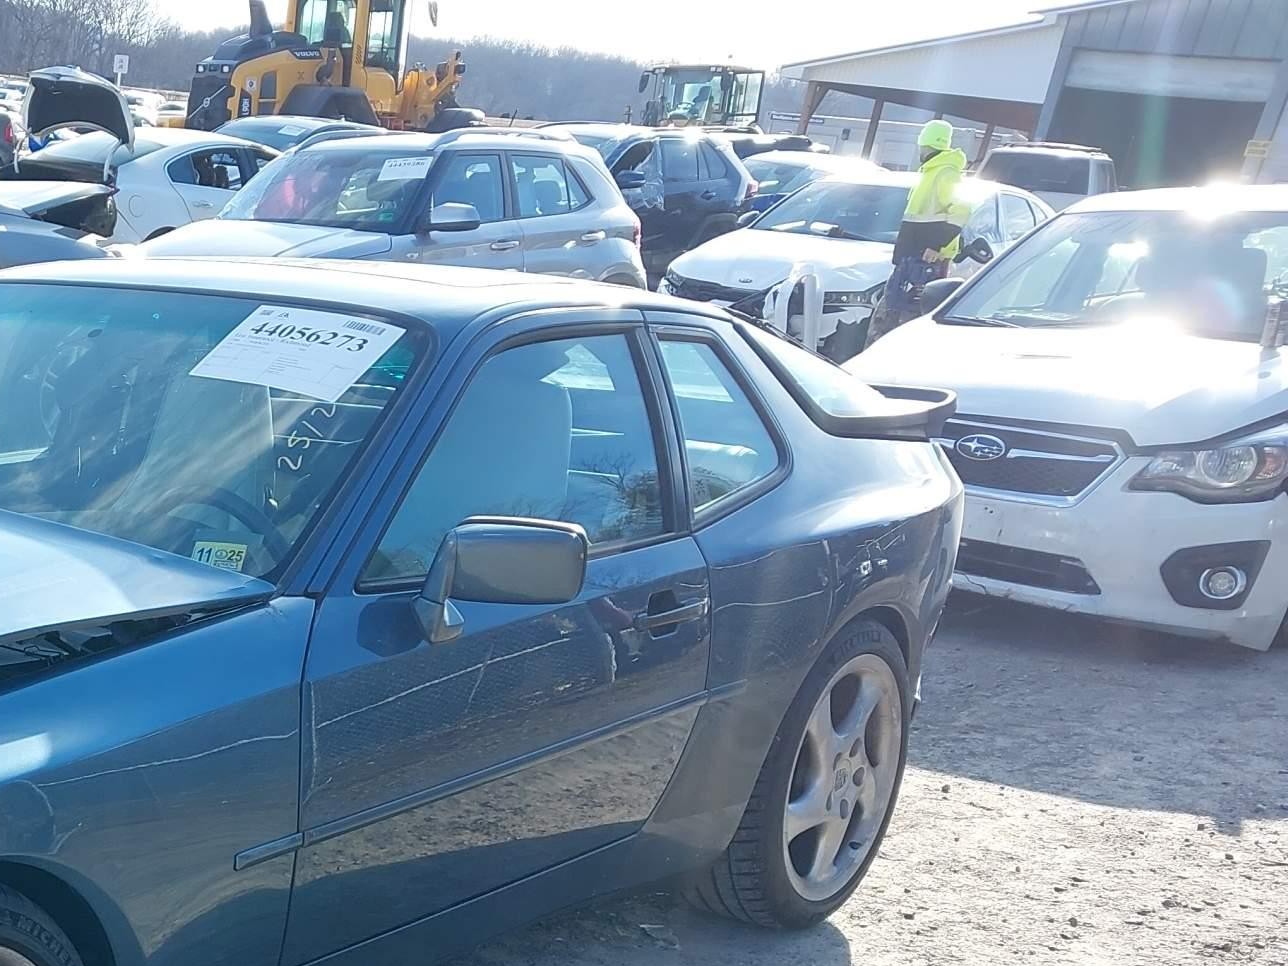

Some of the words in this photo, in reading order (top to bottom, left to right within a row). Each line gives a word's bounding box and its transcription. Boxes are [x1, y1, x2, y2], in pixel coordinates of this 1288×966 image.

[250, 320, 369, 353] 44056273
[197, 547, 212, 563] 11
[227, 550, 243, 561] 25
